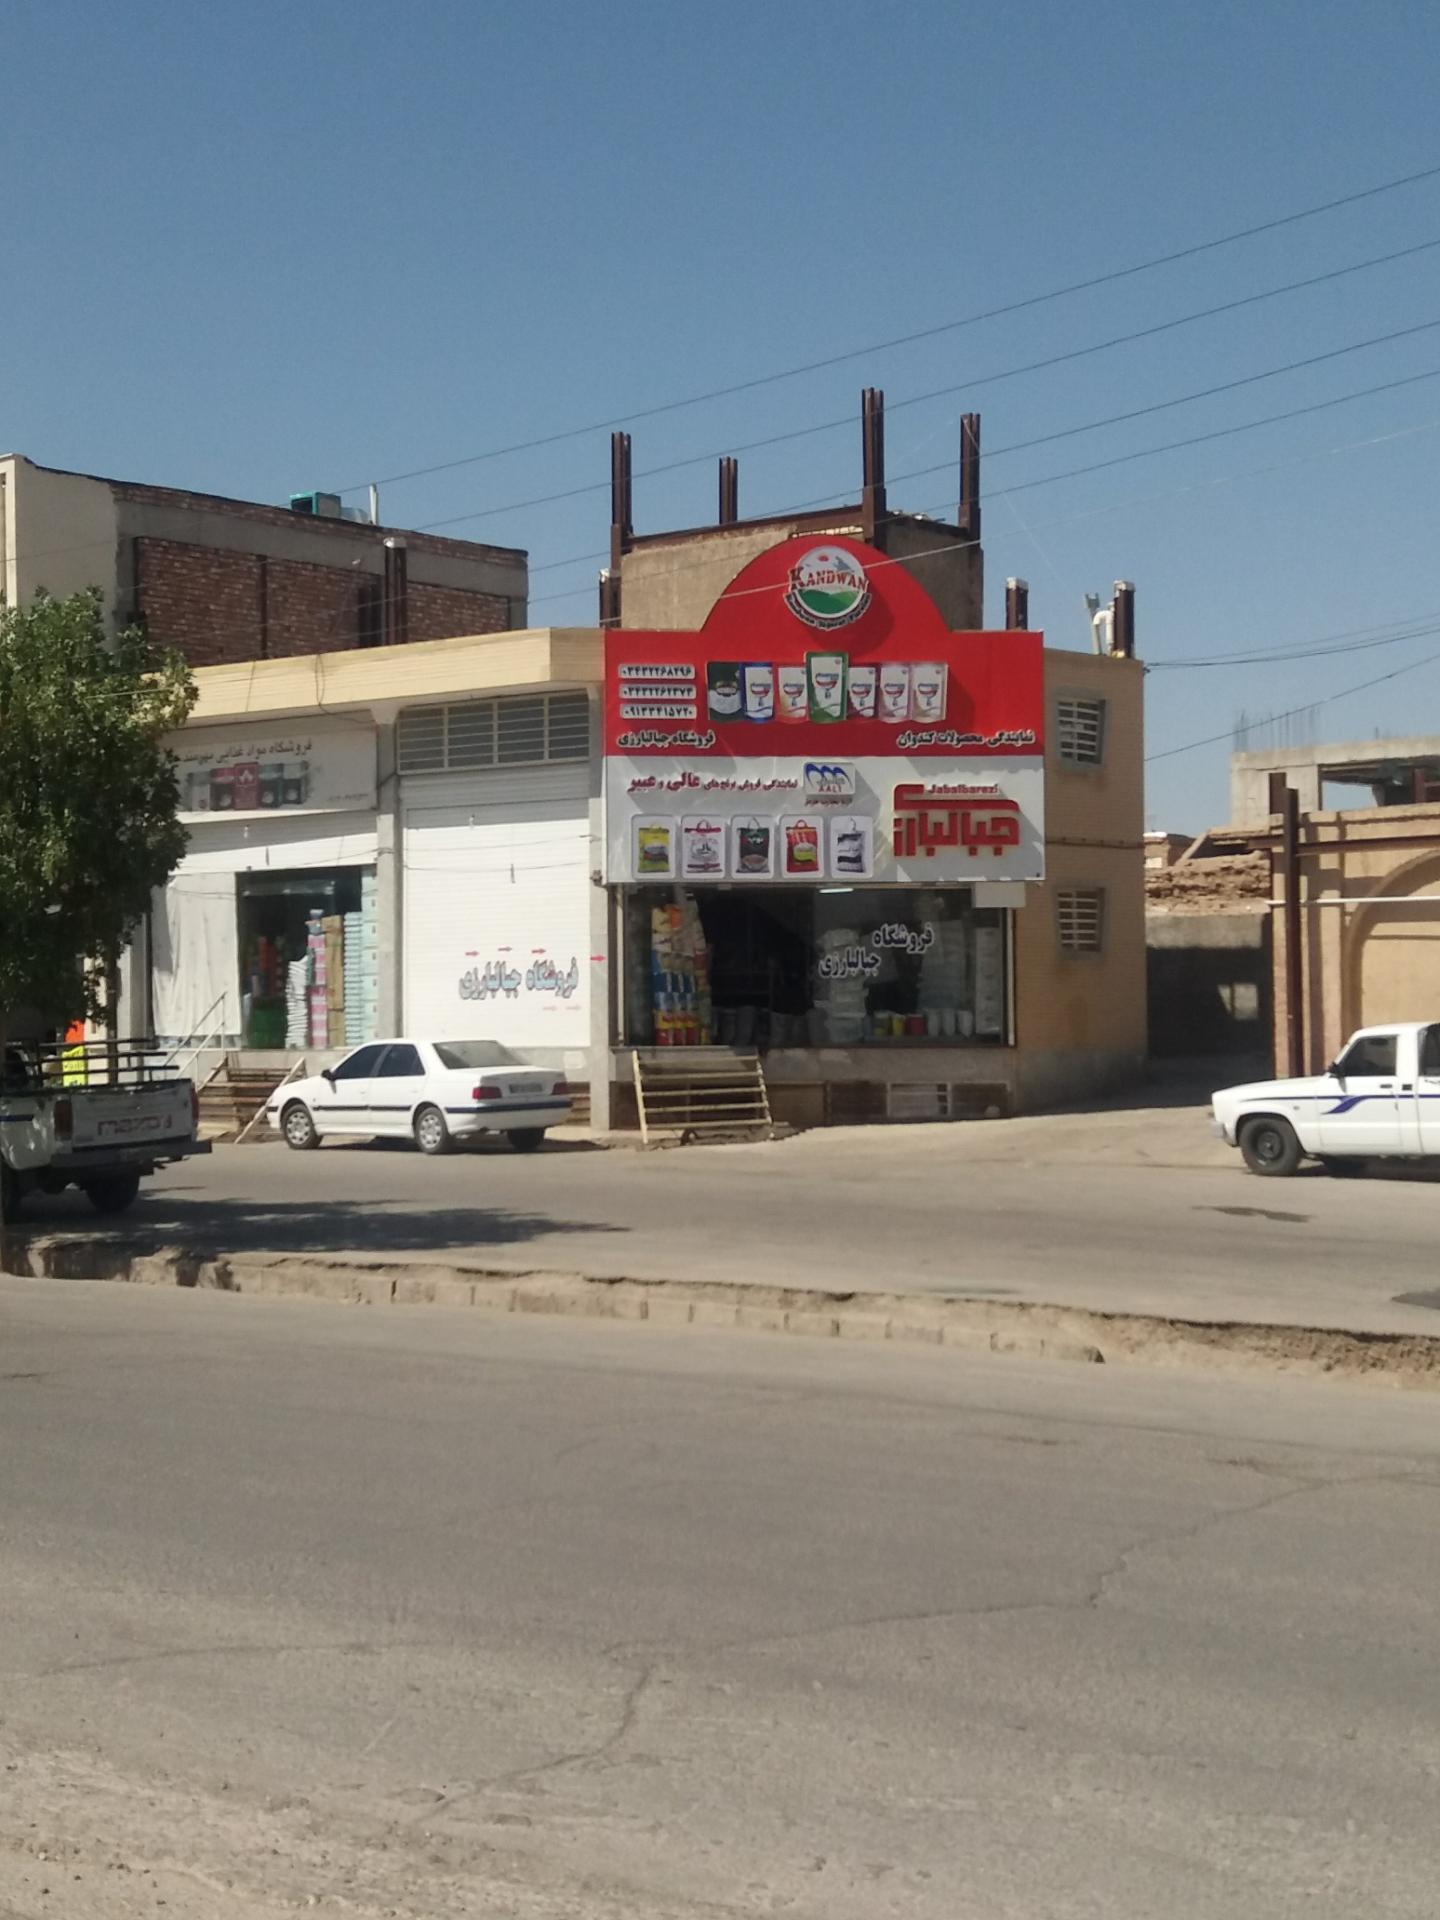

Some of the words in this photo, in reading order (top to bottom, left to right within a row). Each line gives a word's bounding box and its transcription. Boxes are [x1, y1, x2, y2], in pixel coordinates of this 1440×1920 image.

[789, 565, 868, 592] KANDWAN
[270, 738, 312, 756] فروشگاه
[617, 730, 671, 748] جبالبارزی
[671, 730, 716, 748] فروشگاه
[896, 731, 937, 749] کندوان
[937, 730, 986, 748] محصولات
[988, 729, 1035, 747] نمایندگی
[247, 744, 266, 760] مواد
[666, 771, 701, 791] عالی
[738, 777, 761, 791] فروش
[763, 778, 799, 791] نمایندگی
[872, 921, 935, 954] فروشگاه
[818, 946, 881, 978] جبالبارزی
[458, 961, 522, 1000] جبالبارزی
[526, 957, 579, 999] فروشگاه
